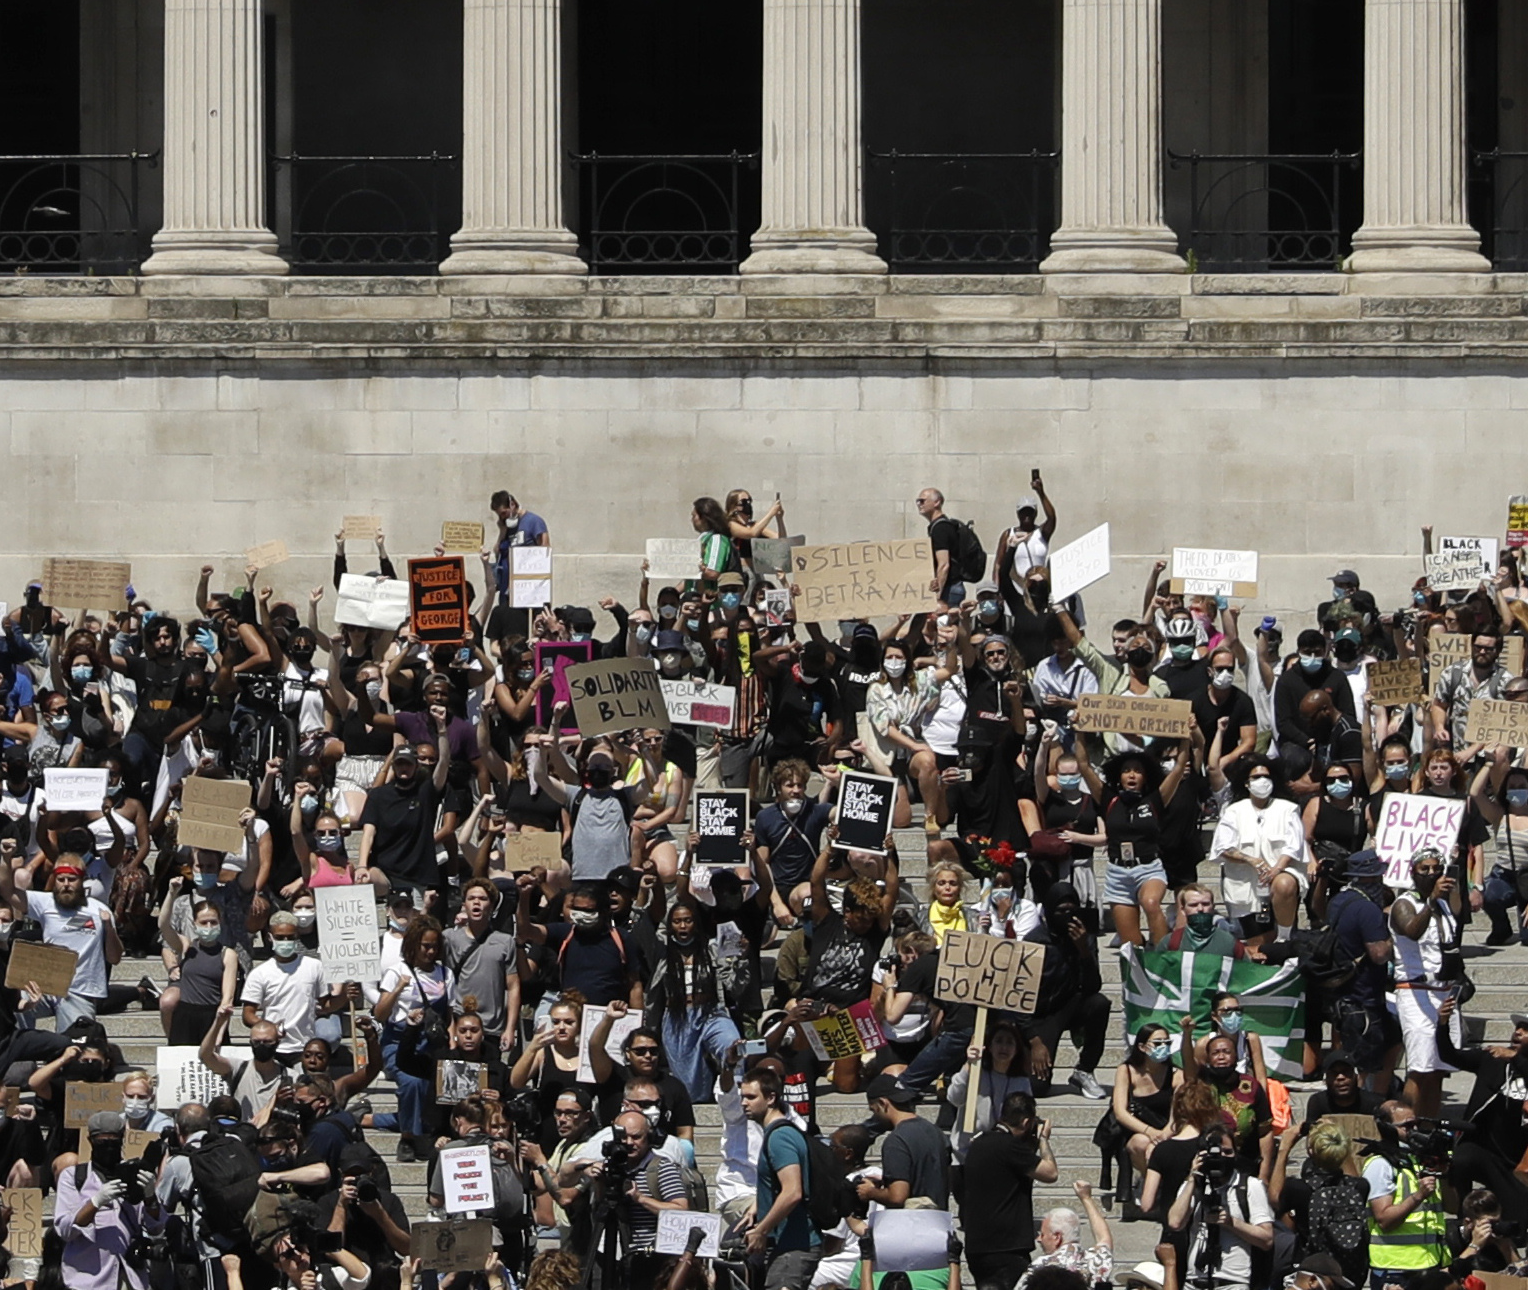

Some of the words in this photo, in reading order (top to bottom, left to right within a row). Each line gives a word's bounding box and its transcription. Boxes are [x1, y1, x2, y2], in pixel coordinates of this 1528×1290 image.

[1443, 538, 1481, 549] BLACK
[811, 543, 928, 573] SILENCE
[416, 569, 458, 582] JUSTICE
[850, 569, 873, 586] IS
[1426, 566, 1481, 586] BREATHE
[429, 591, 451, 602] FOR
[804, 581, 932, 610] BETRAYAL
[420, 612, 459, 626] GEORGE
[1371, 661, 1419, 677] BLACK
[1373, 675, 1411, 687] LIVES
[598, 699, 656, 724] BLM
[667, 700, 689, 717] IVES
[1092, 713, 1122, 729] NOT
[1123, 715, 1135, 729] A
[1137, 718, 1188, 735] CRIME!
[1501, 714, 1518, 727] IS
[847, 780, 874, 794] STAY
[699, 798, 726, 808] STAY
[844, 799, 872, 812] STAY
[845, 790, 883, 806] BLACK
[699, 807, 738, 818] BLACK
[843, 808, 879, 823] HOMIE
[1384, 801, 1461, 833] BLACK
[699, 816, 726, 827] STAY
[699, 826, 736, 836] HOMIE
[1380, 829, 1448, 853] LIVES
[324, 898, 363, 915] WHITE
[327, 913, 372, 932] SILENCE
[323, 943, 378, 960] VIOLENCE
[943, 934, 1039, 978] FUCK
[330, 959, 376, 978] #BLM
[950, 964, 1029, 991] THE
[937, 977, 1036, 1011] POLICE
[836, 1012, 863, 1054] MATTER
[461, 1182, 478, 1190] THE
[458, 1193, 490, 1203] POLICE?
